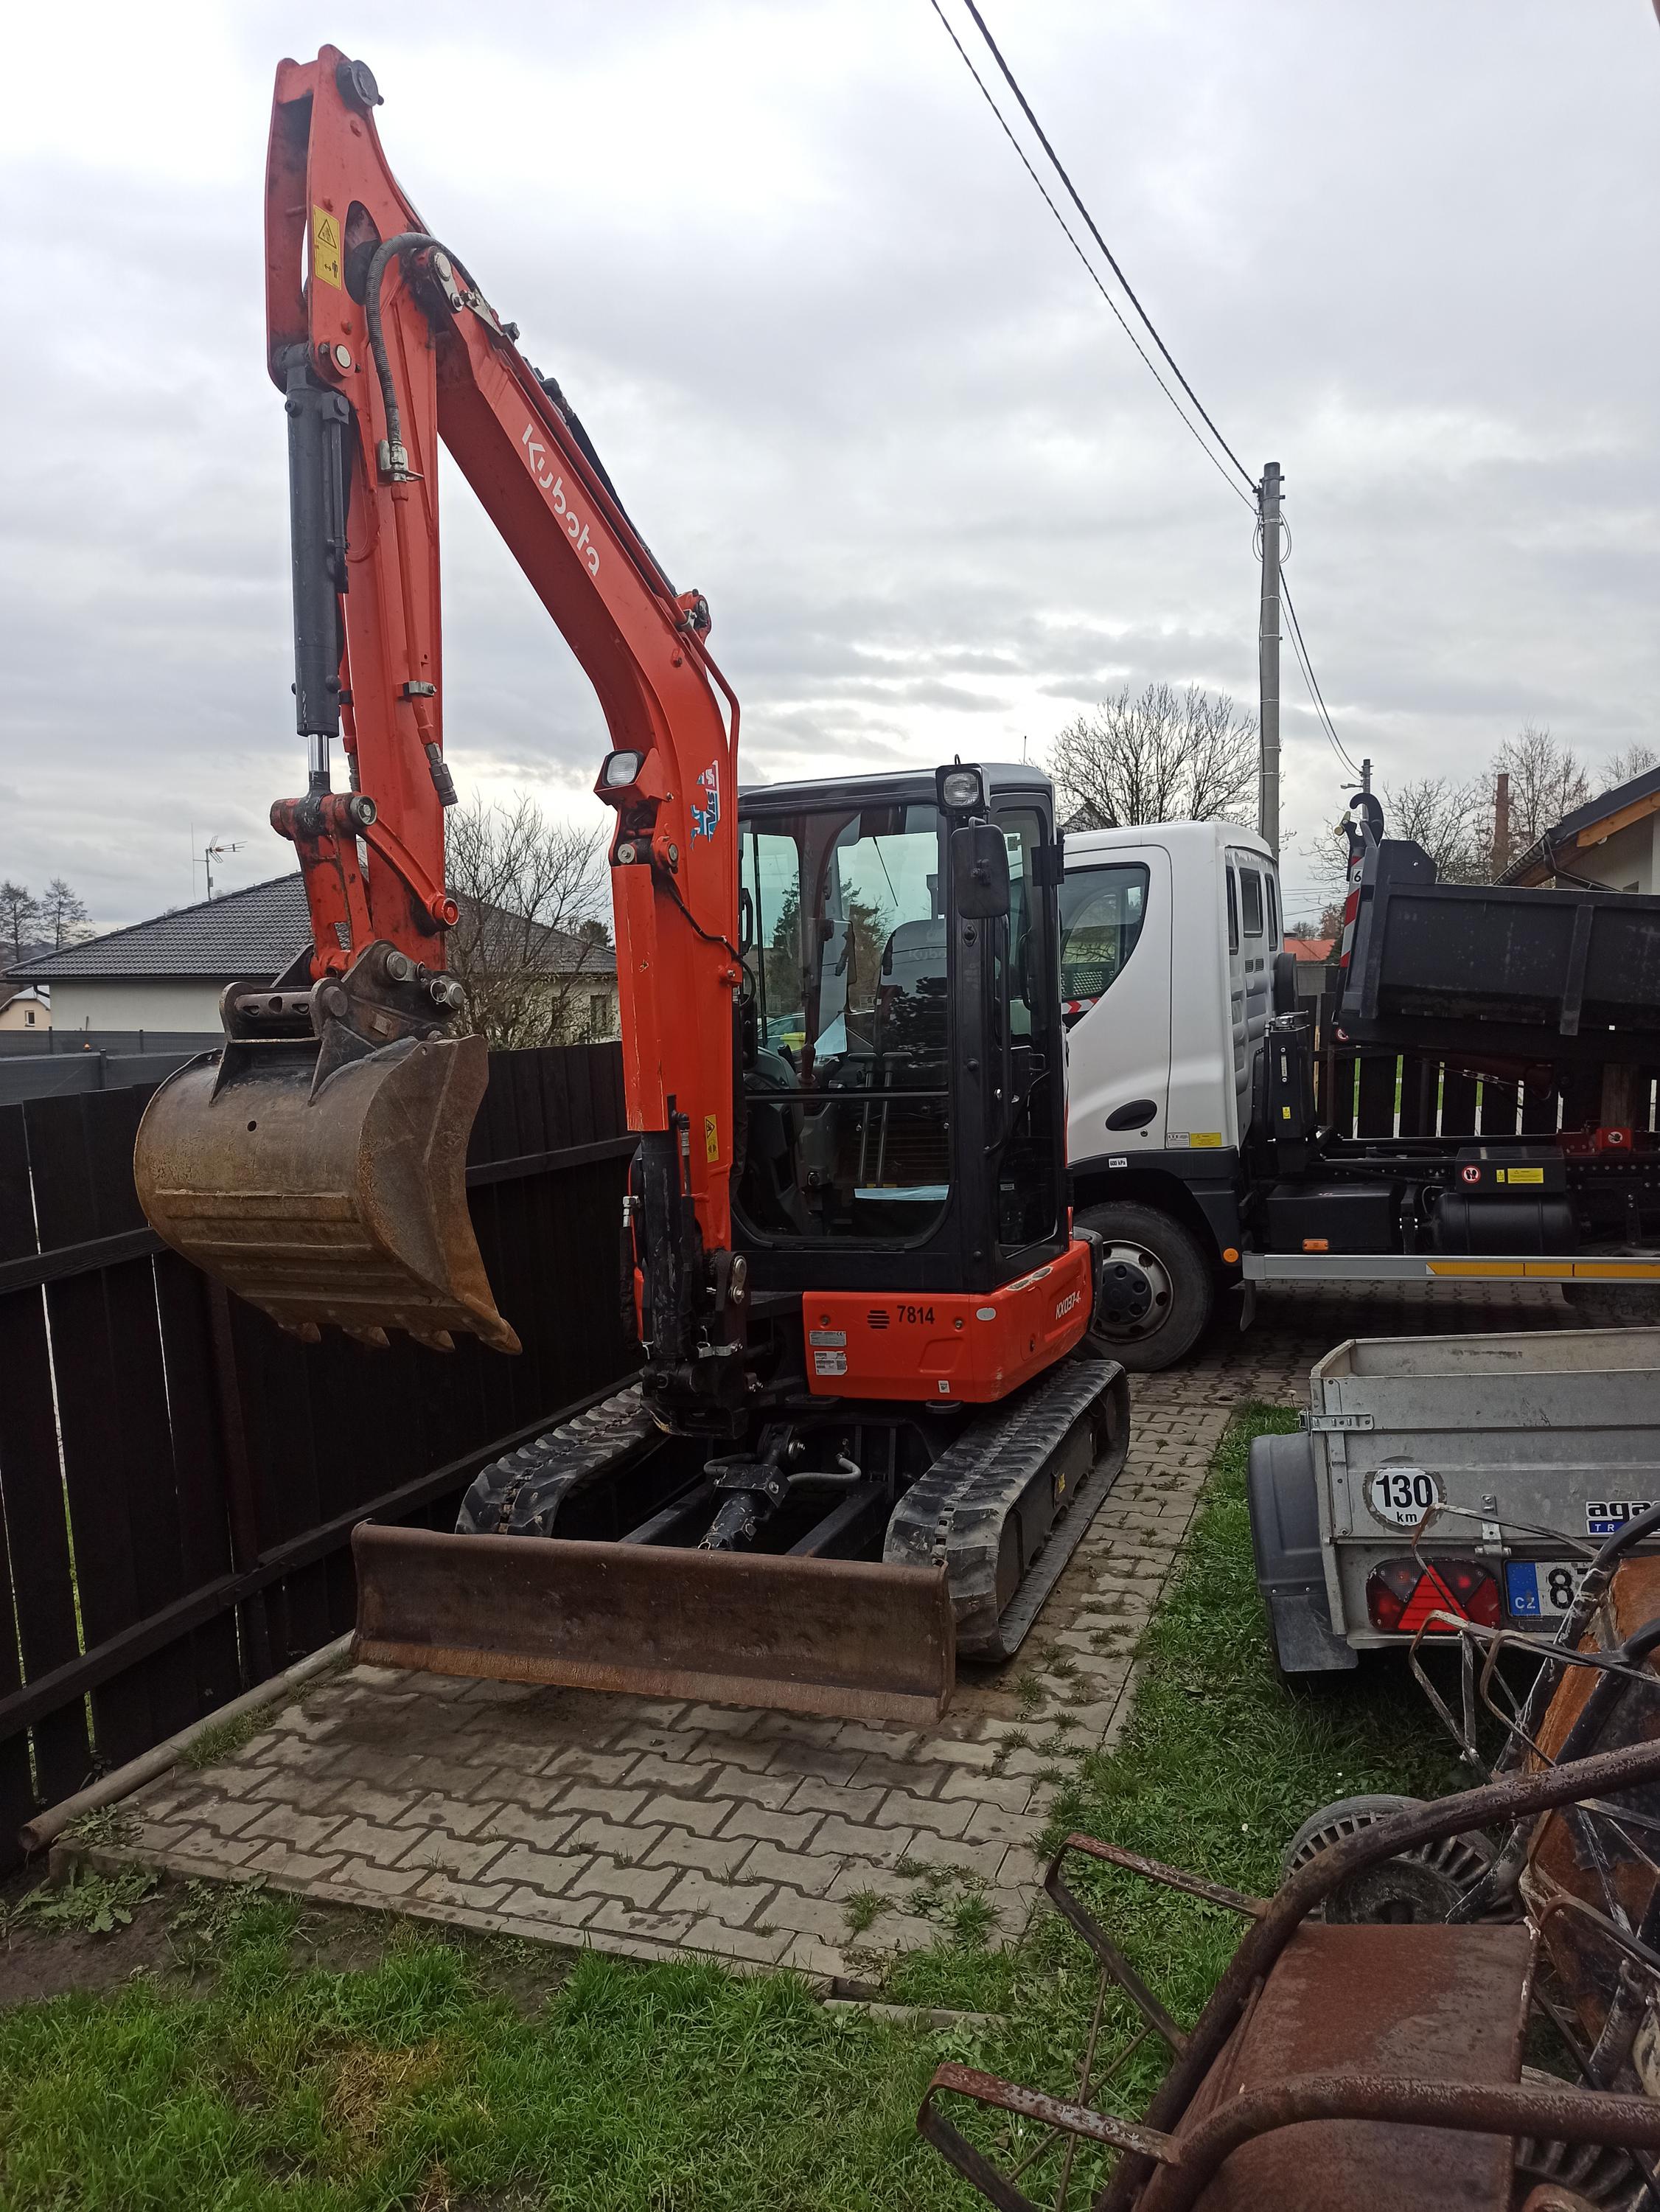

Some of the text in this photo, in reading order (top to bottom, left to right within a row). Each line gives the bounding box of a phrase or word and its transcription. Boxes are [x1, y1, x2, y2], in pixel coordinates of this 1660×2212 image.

[522, 423, 600, 577] Kubota
[1353, 870, 1362, 883] 6
[909, 948, 946, 960] Kubo
[1055, 1290, 1081, 1320] KX037-4
[896, 1305, 935, 1324] 7814
[1375, 1475, 1433, 1508] 130
[1396, 1511, 1417, 1523] km
[1588, 1501, 1656, 1526] aga
[1594, 1523, 1615, 1532] TR
[1514, 1596, 1536, 1609] CZ
